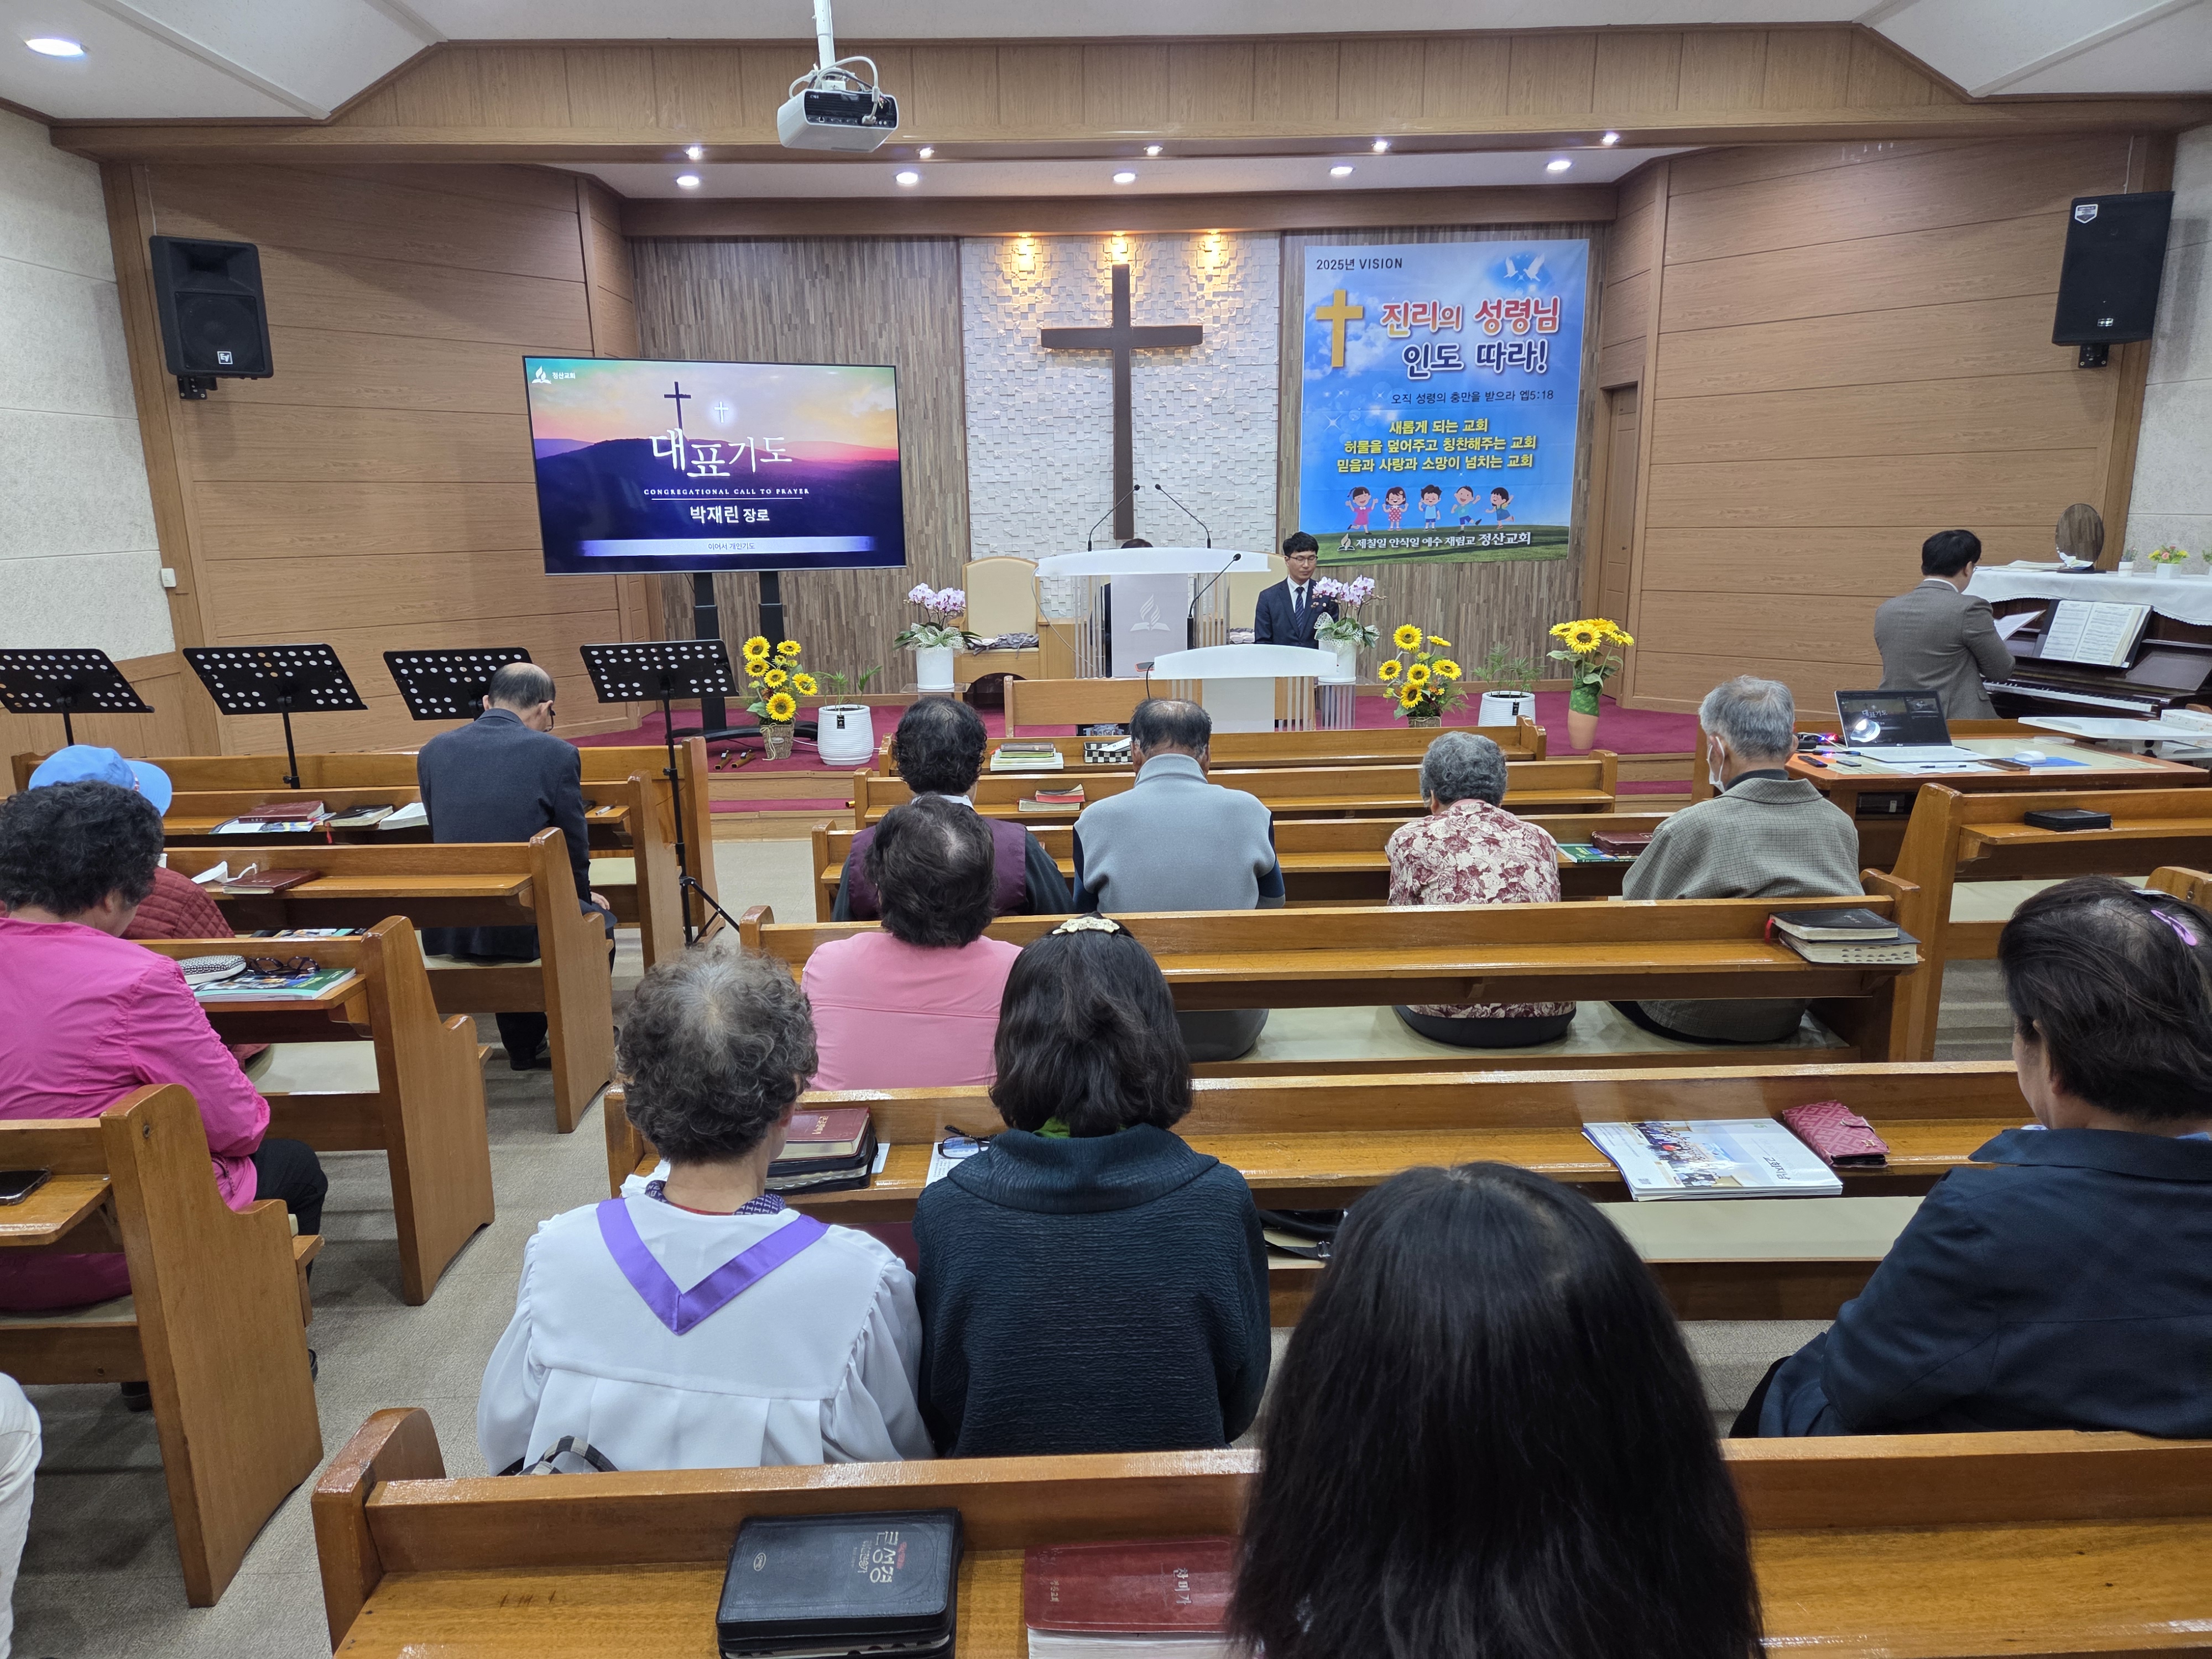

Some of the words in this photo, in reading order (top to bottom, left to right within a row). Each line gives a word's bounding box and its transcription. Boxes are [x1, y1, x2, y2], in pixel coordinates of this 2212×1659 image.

[1316, 258, 1355, 270] 2025년
[1359, 258, 1402, 269] VISION
[1381, 300, 1461, 335] 진리의
[1474, 297, 1558, 333] 성령님
[1404, 344, 1462, 377] 인도
[1477, 340, 1547, 371] 따라!
[552, 371, 576, 379] 정산교회
[1391, 393, 1412, 404] 오직
[1416, 392, 1446, 404] 성령의
[1450, 391, 1481, 403] 충만을
[1485, 390, 1516, 401] 받으라
[1520, 390, 1554, 400] 엡5:18
[1389, 420, 1428, 434] 새롭게
[1432, 419, 1458, 433] 되는
[1462, 418, 1488, 432] 교회
[649, 427, 793, 477] 대표기도
[1344, 440, 1383, 454] 허물을
[1387, 439, 1438, 453] 덮어주고
[1443, 436, 1506, 451] 칭찬해주는
[1510, 435, 1537, 449] 교회
[1337, 458, 1375, 472] 믿음과
[1379, 457, 1417, 471] 사랑과
[1422, 456, 1460, 470] 소망이
[1465, 455, 1503, 469] 넘치는
[1507, 454, 1533, 467] 교회
[690, 505, 739, 524] 박재린
[743, 508, 770, 523] 장로
[729, 542, 755, 550] 개인기도
[1356, 538, 1386, 549] 제칠일
[1389, 537, 1420, 549] 안식일
[1422, 536, 1443, 547] 예수
[1444, 535, 1476, 546] 재림교
[1478, 532, 1531, 546] 정산교회
[1762, 1157, 1791, 1180] 교회지남
[1173, 1567, 1192, 1605] 찬미가
